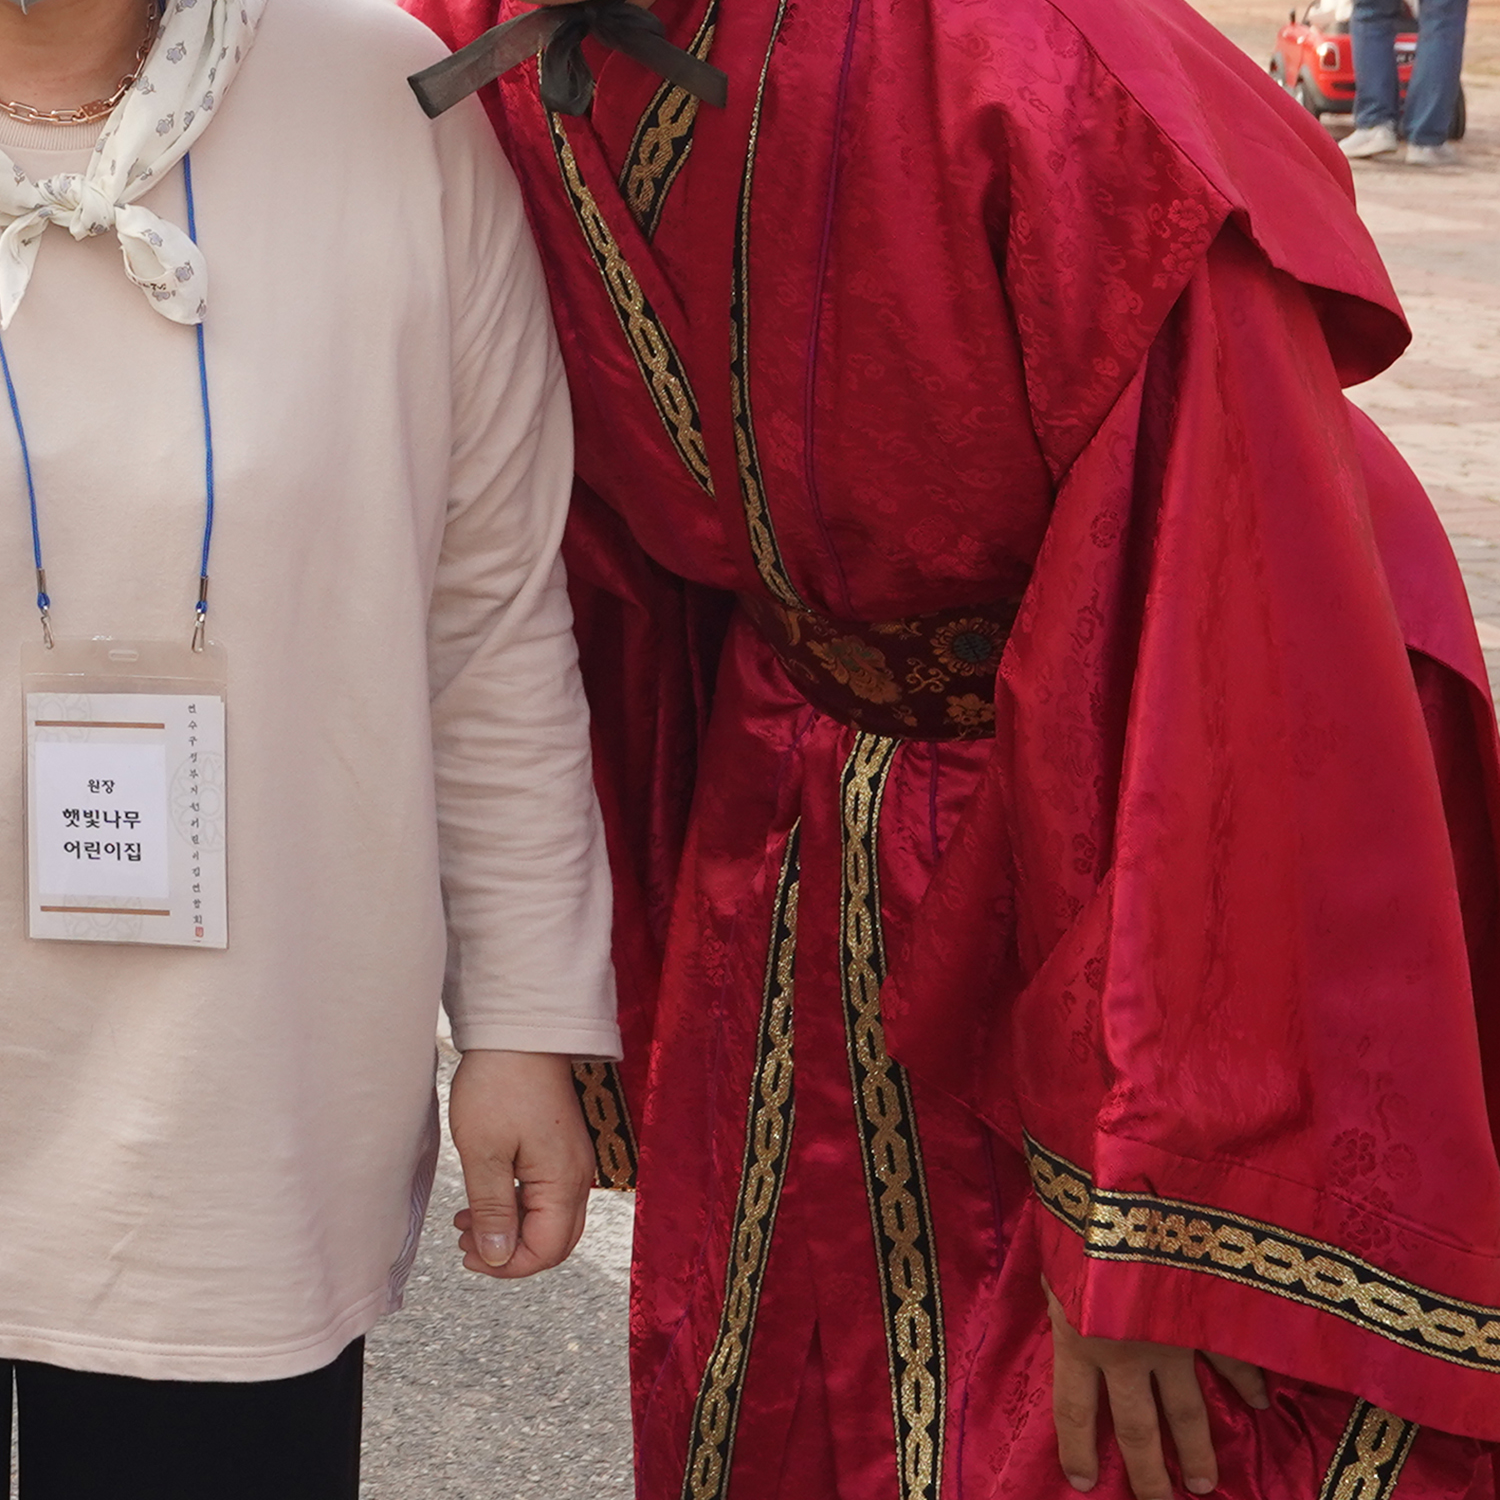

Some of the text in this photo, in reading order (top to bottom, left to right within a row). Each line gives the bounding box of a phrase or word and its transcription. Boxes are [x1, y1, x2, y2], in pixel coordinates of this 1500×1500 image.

[87, 779, 115, 794] 원장
[62, 808, 142, 830] 햇빛나무
[63, 841, 142, 862] 어린이집
